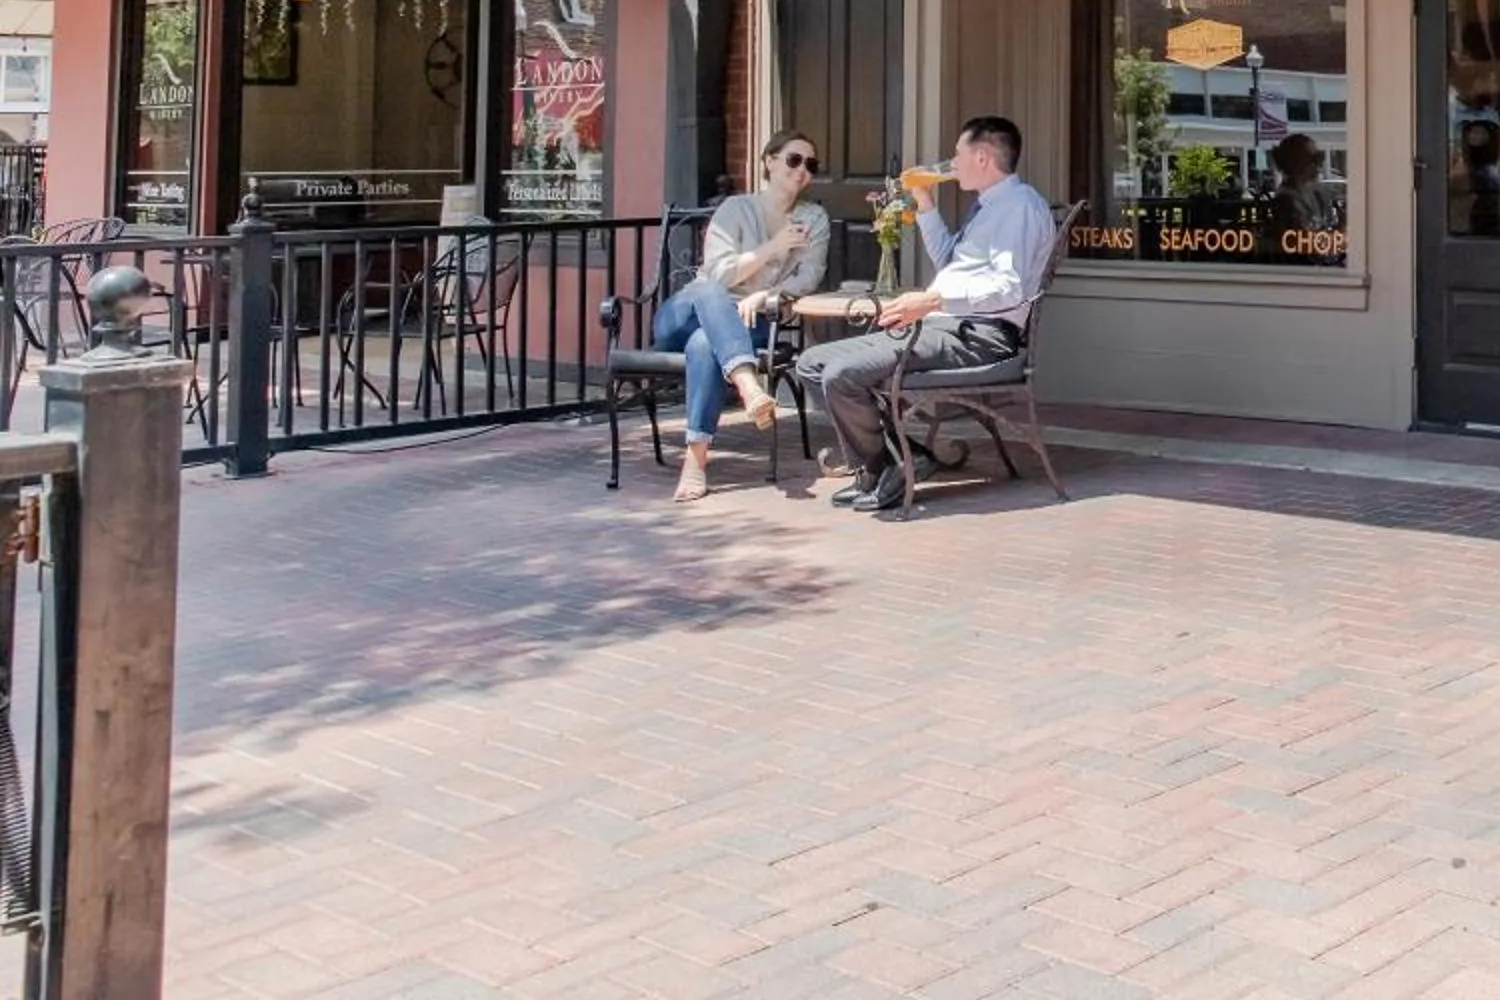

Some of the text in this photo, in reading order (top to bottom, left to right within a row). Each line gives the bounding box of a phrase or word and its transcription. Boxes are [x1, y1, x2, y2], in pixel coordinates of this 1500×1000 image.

[514, 55, 605, 87] LANDON
[296, 178, 410, 196] Private Parties
[1070, 226, 1349, 255] STEAKS SEAFOOD CHOP
